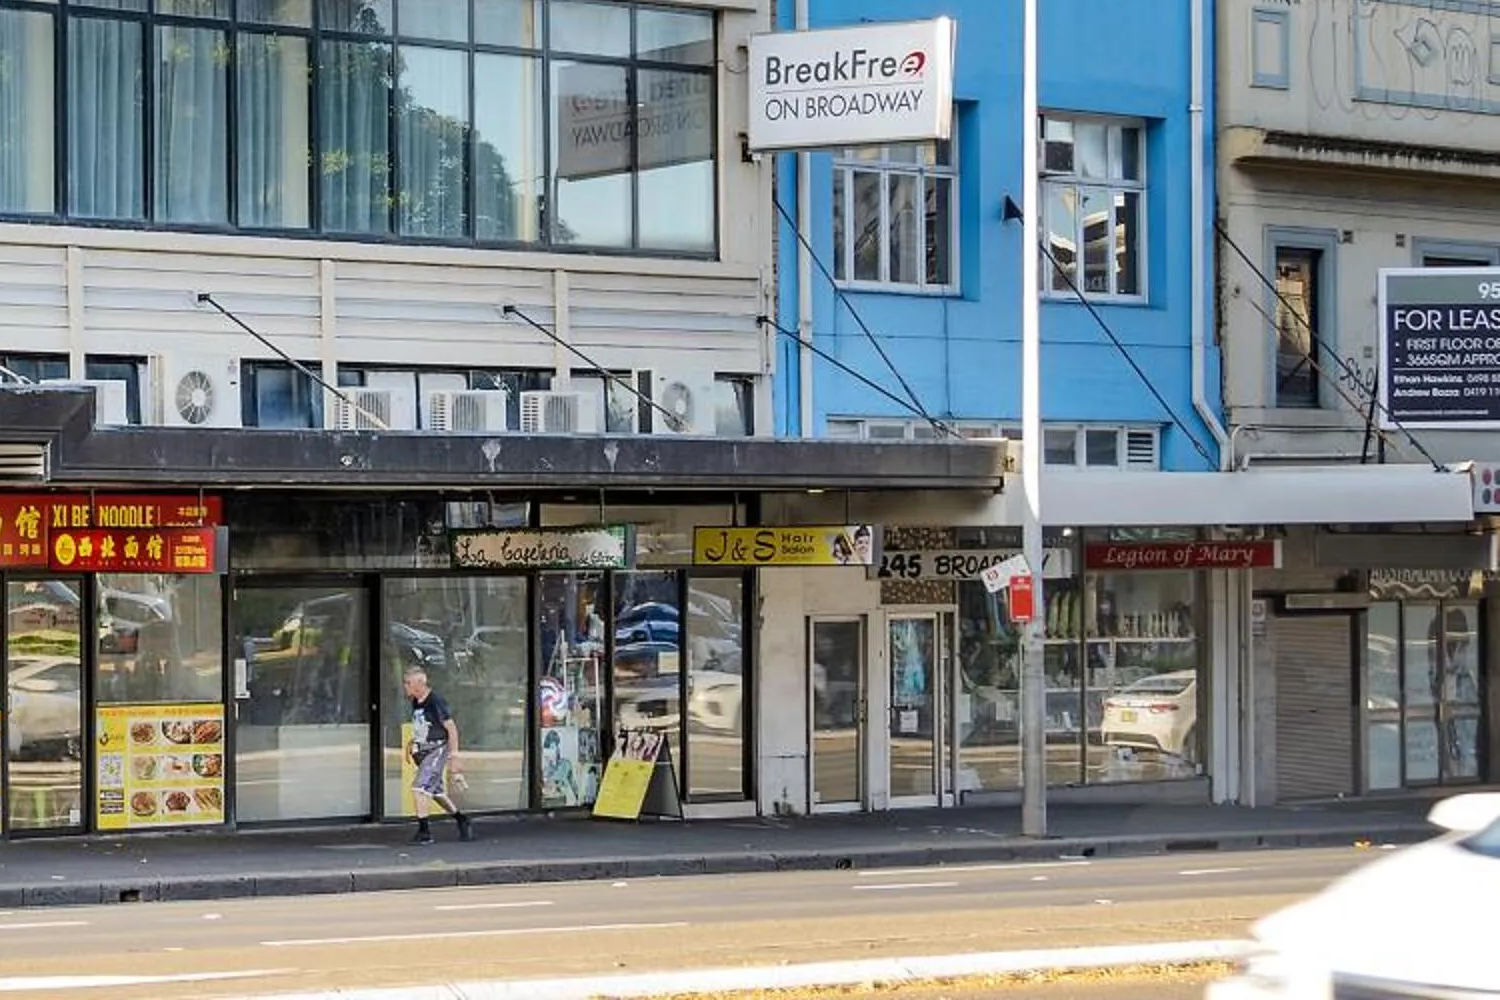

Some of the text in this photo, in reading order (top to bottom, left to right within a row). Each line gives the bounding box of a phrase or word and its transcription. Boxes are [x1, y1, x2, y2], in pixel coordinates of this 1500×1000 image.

[765, 50, 926, 85] BreakFree
[765, 90, 923, 121] ON BROADWAY
[1394, 309, 1500, 331] FOR LEAS
[1406, 338, 1437, 350] FIRST
[1440, 337, 1483, 350] FLOOR
[52, 505, 67, 528] XI
[71, 505, 90, 528] BE
[99, 504, 154, 528] NOODLE
[781, 533, 815, 543] Hair
[1104, 543, 1254, 568] Legion of Mary
